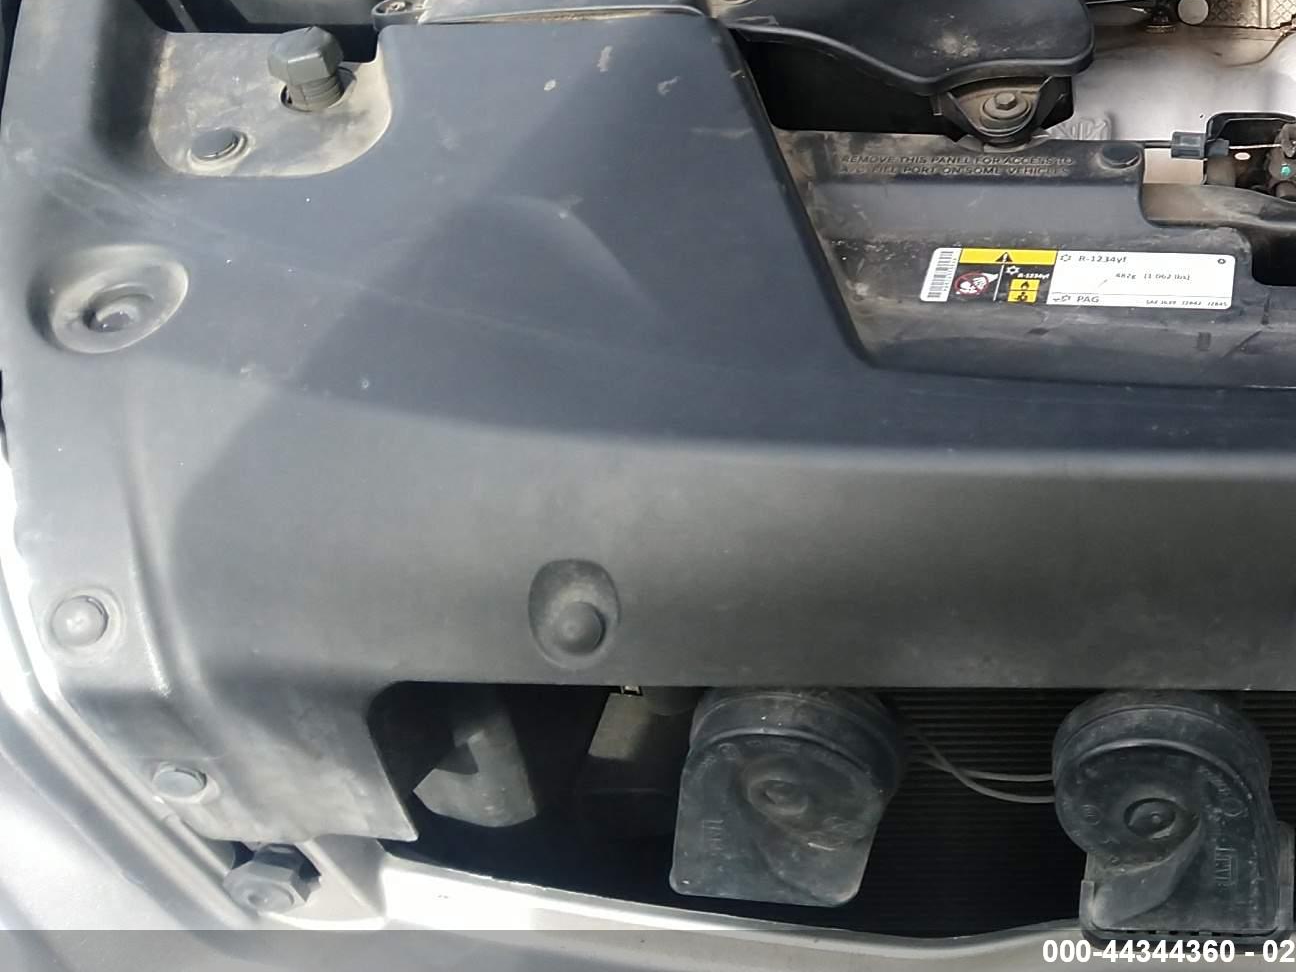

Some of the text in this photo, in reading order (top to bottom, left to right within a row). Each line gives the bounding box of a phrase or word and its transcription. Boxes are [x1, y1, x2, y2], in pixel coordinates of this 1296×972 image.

[841, 155, 1074, 166] REMOVE THIS PANEL FOR ACCESS TO
[903, 165, 936, 175] PORT
[943, 166, 962, 175] ON
[966, 166, 1001, 175] SOME
[1078, 255, 1128, 264] R-1234yf
[1076, 294, 1100, 303] PAG
